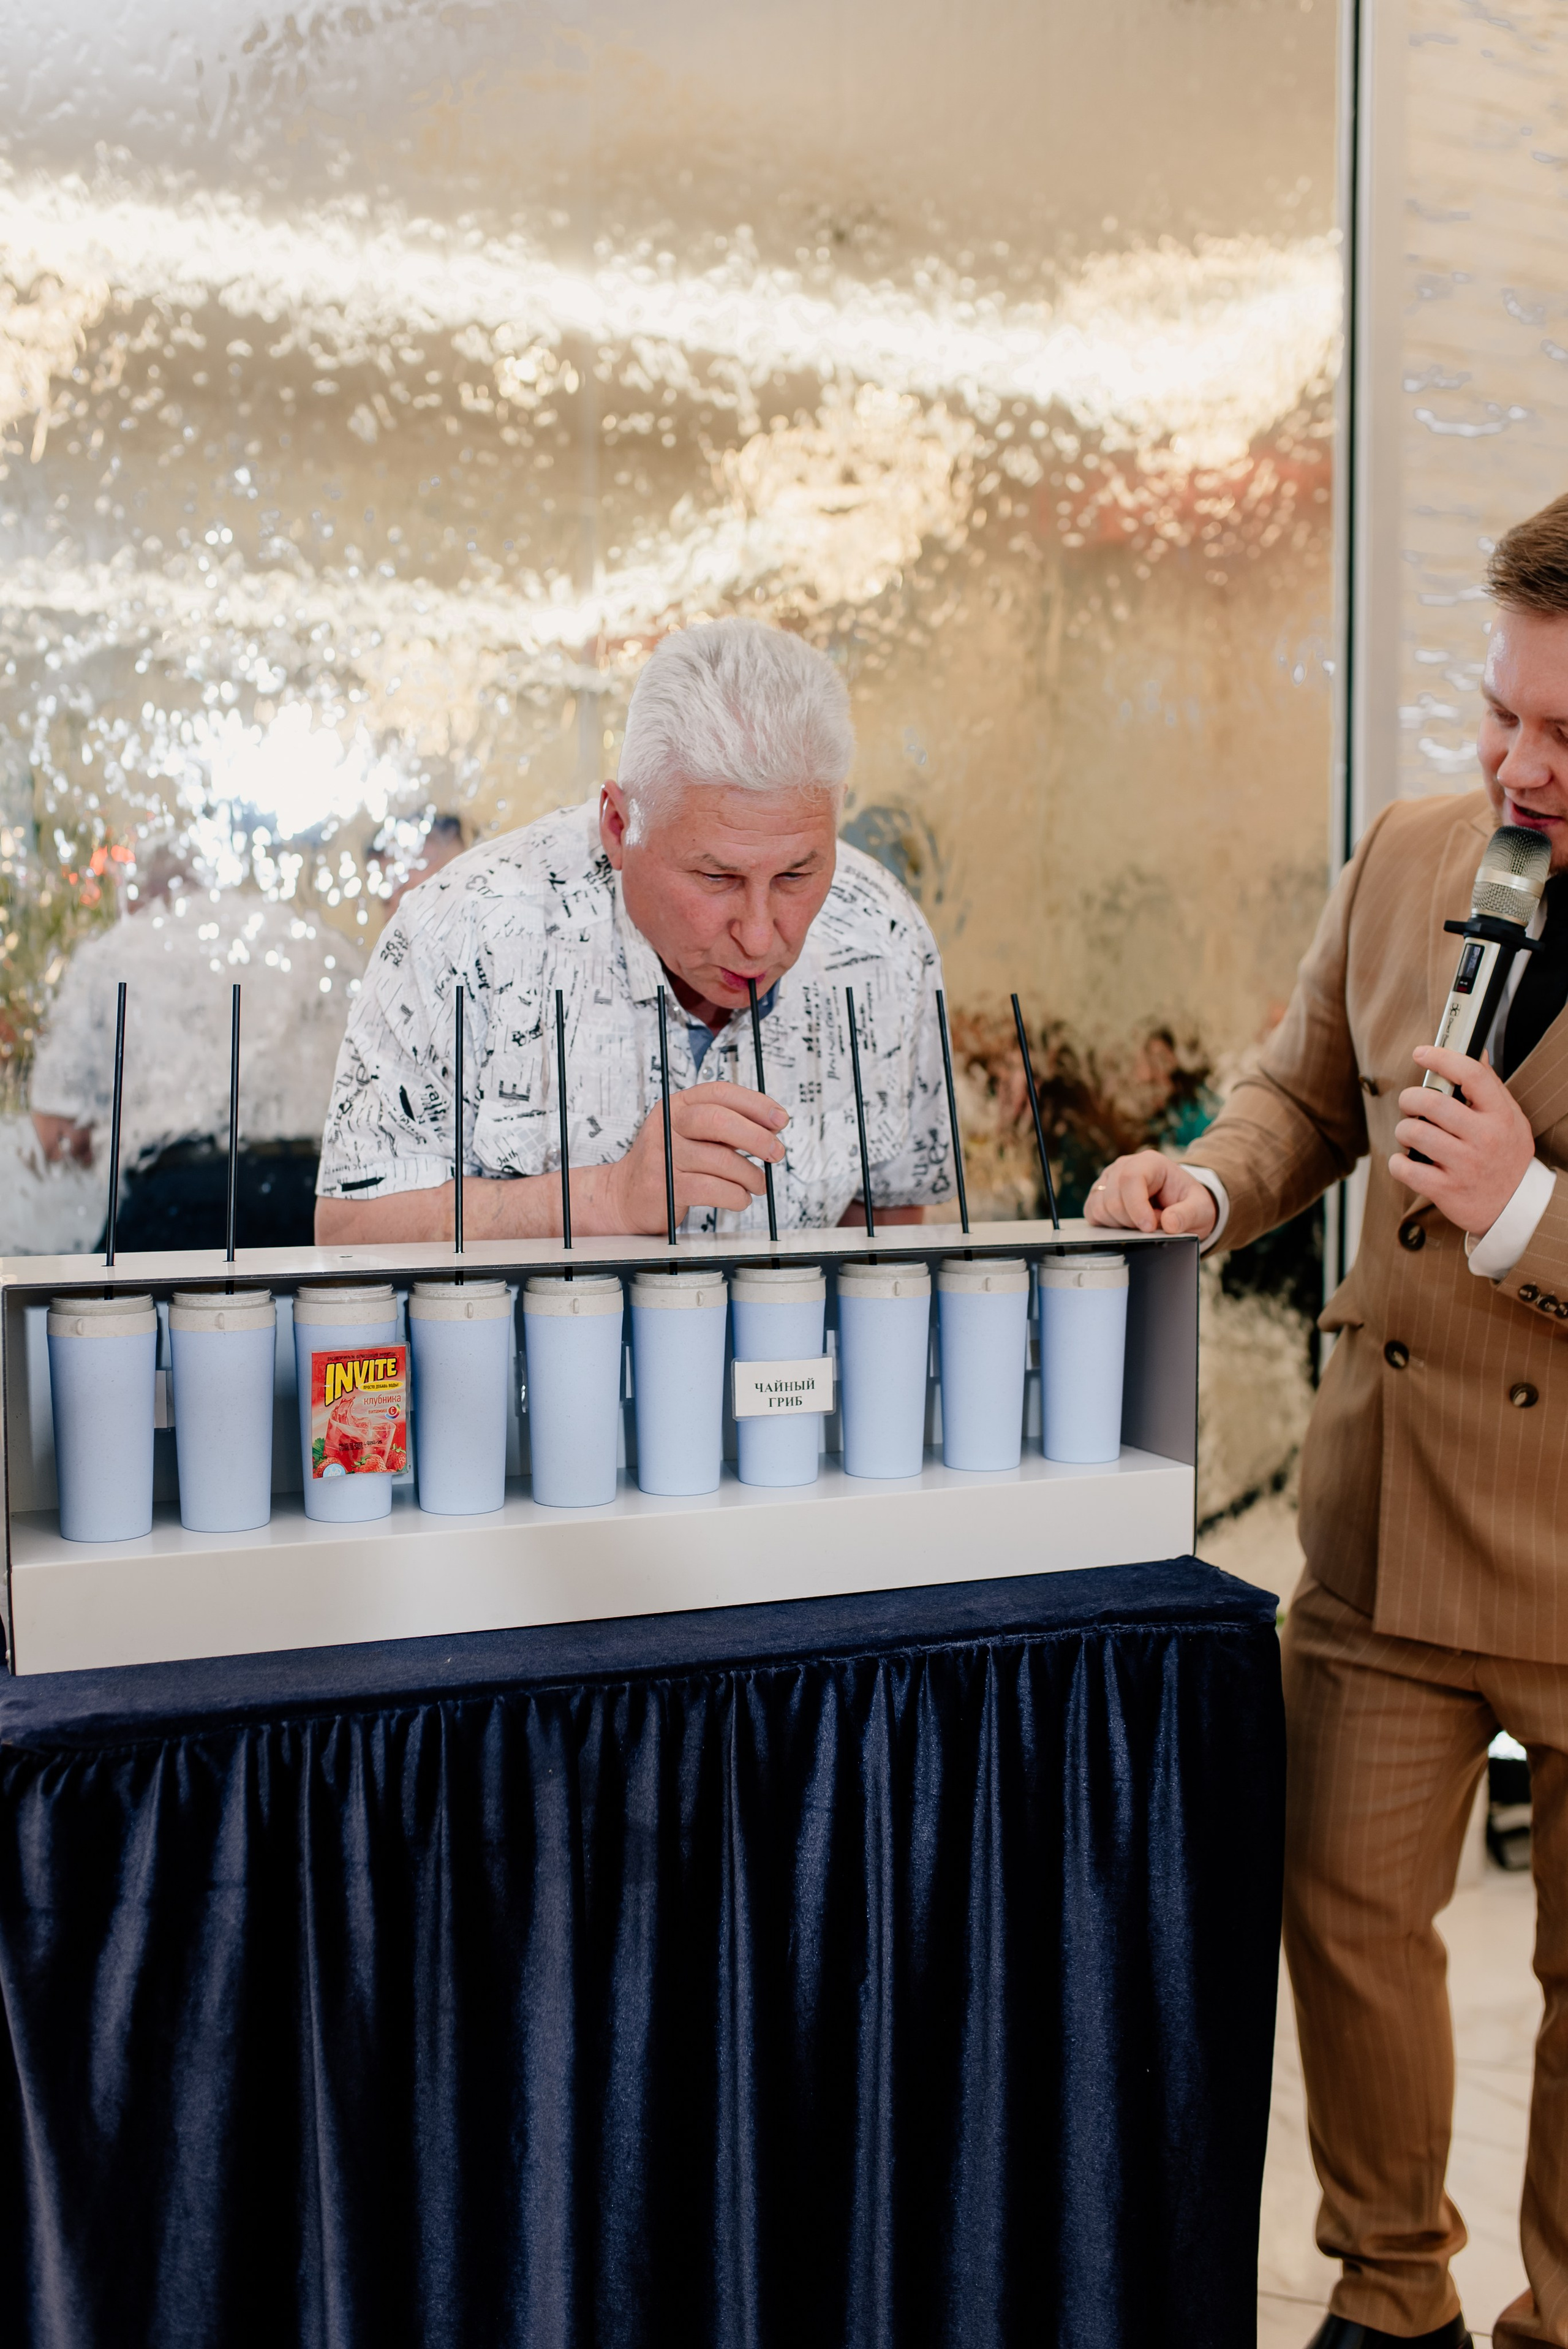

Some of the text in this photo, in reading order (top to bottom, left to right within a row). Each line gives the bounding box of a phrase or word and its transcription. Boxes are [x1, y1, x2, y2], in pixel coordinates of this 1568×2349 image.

[325, 1357, 398, 1407] INVITE
[755, 1377, 815, 1393] ЧАЙНЫЙ
[364, 1394, 401, 1407] клубника
[769, 1396, 803, 1408] ГРИБ
